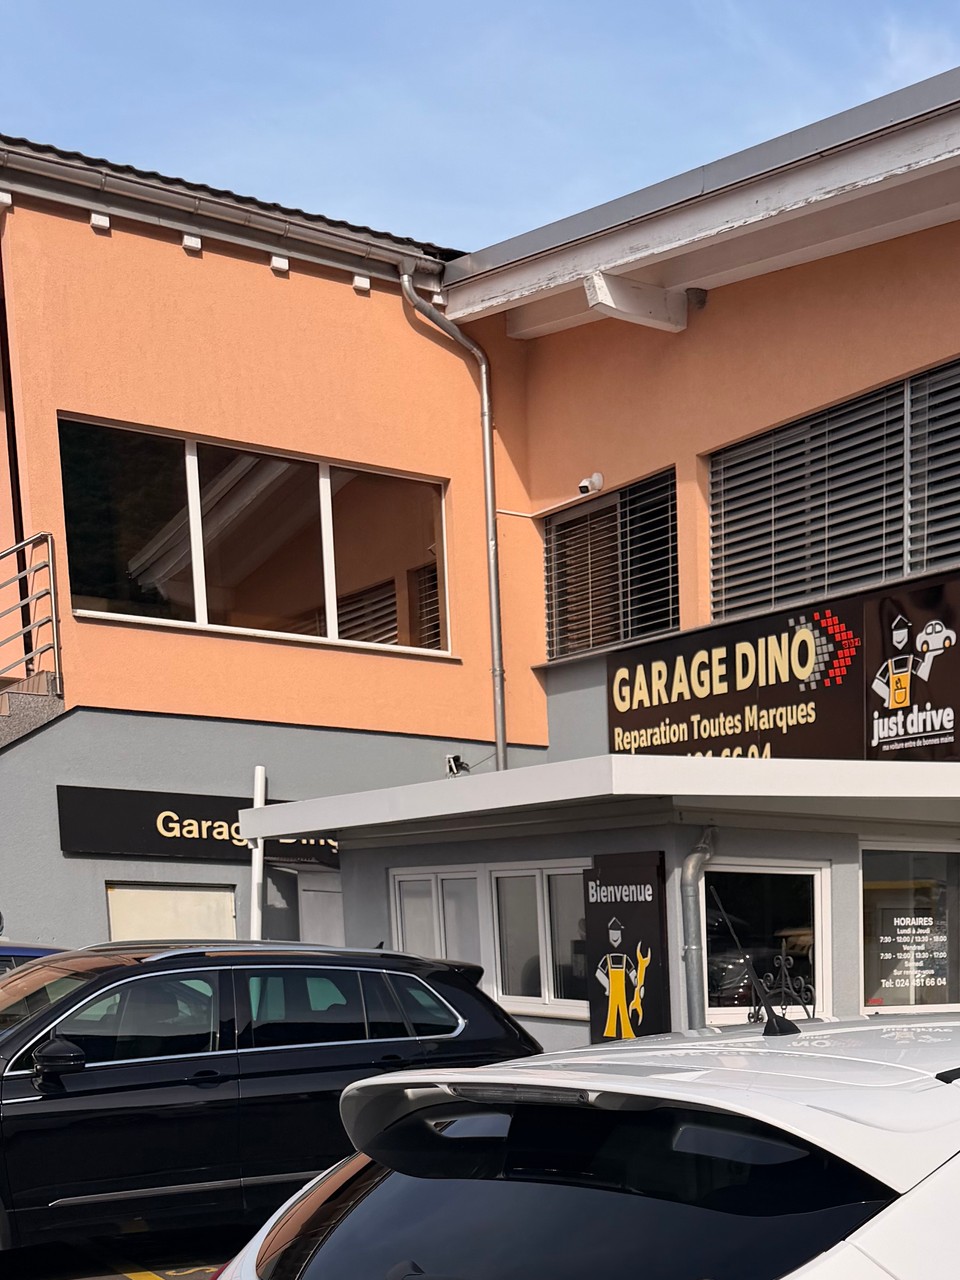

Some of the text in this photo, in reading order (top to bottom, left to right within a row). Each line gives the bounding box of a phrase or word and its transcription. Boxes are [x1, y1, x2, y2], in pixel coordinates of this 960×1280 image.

[612, 628, 816, 713] GARAGE DINO
[613, 701, 816, 754] Reparation Toutes Marques
[871, 702, 955, 747] just drive
[156, 811, 248, 847] Garag
[588, 880, 653, 903] Bienvenue
[894, 917, 934, 926] HORAIRES
[895, 978, 910, 987] 024
[925, 978, 935, 986] 66
[936, 977, 947, 986] 04
